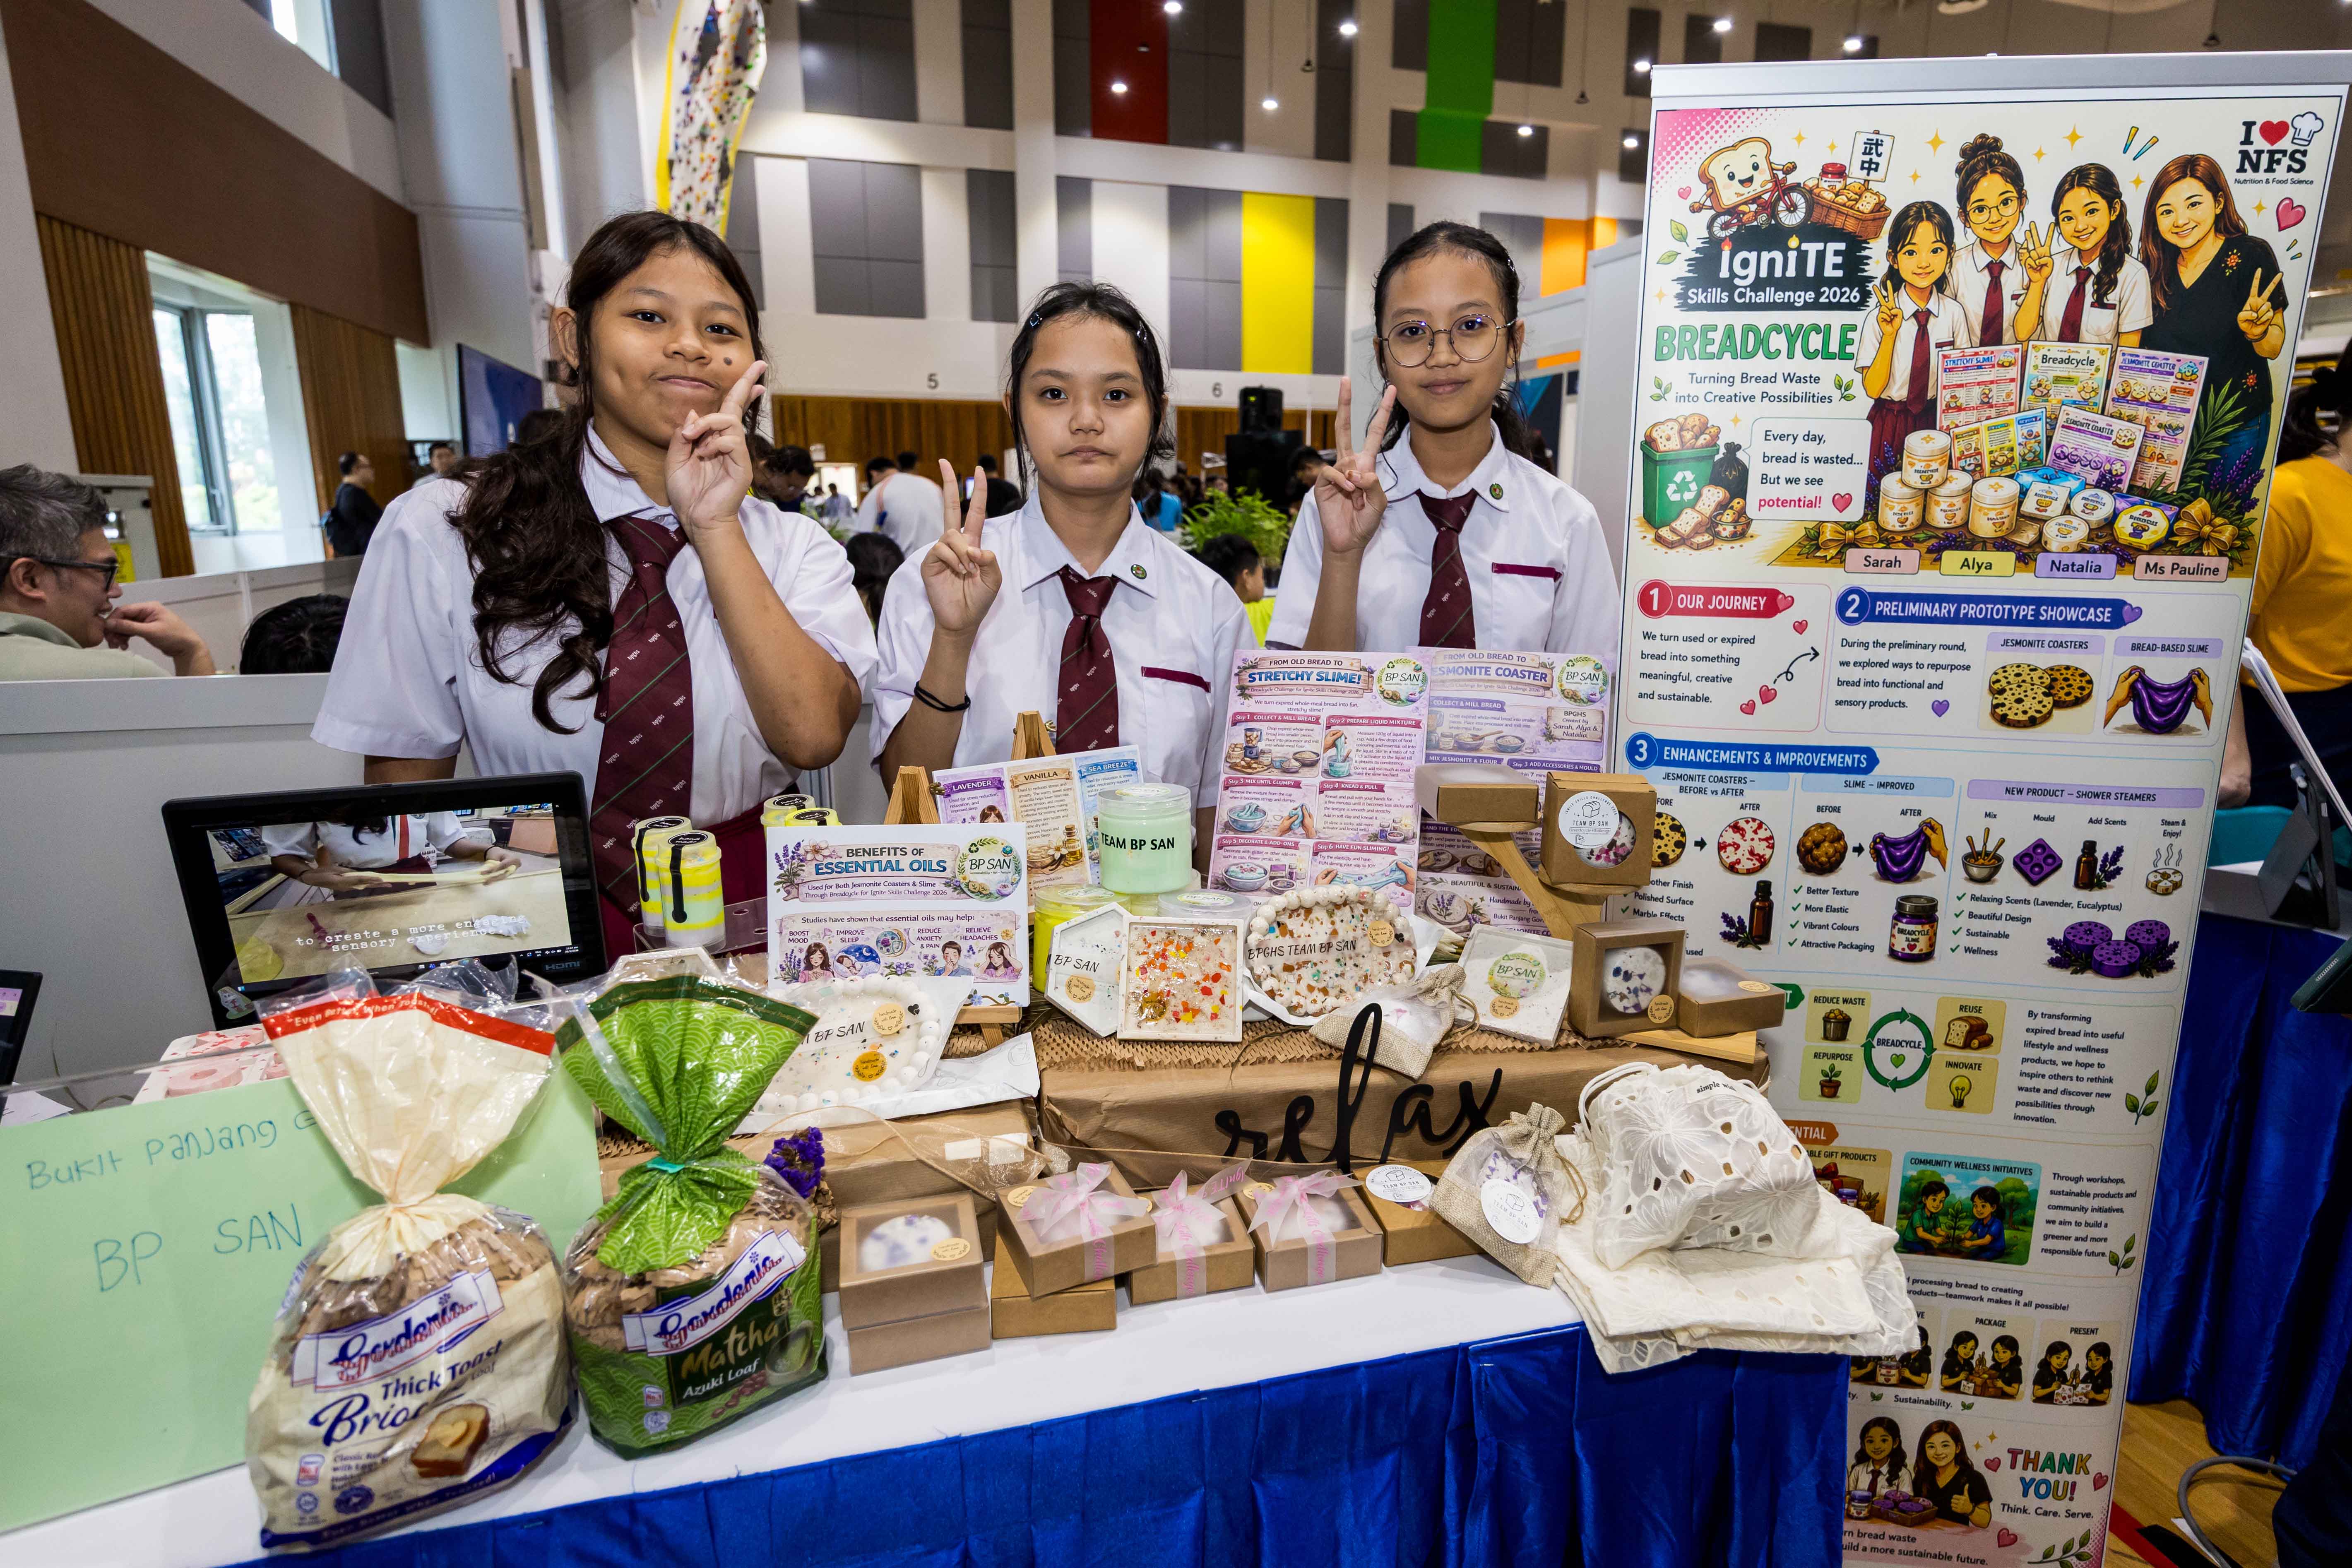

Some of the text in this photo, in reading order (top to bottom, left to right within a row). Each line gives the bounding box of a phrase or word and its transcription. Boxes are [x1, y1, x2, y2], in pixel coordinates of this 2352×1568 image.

[2239, 121, 2257, 146] I
[2236, 149, 2308, 174] NFS
[1687, 286, 1860, 307] Skills Challenge 2026
[1656, 324, 1857, 361] BREADCYCLE
[2041, 354, 2095, 368] Breadcycle
[927, 373, 939, 390] 5
[1688, 372, 1821, 387] Turning Bread Waste
[1212, 382, 1222, 398] 6
[1675, 391, 1833, 404] into Creative Possibilities
[1764, 430, 1826, 445] Every day,
[1763, 452, 1863, 465] bread is wasted...
[1760, 473, 1823, 486] But we see
[1758, 495, 1822, 512] potential!
[1863, 555, 1901, 568] Sarah
[1960, 557, 1992, 570] Alya
[2050, 559, 2102, 573] Natalia
[2145, 562, 2220, 576] Ms Pauline
[1650, 587, 1767, 611] 1 OUR JOURNEY
[1845, 594, 2112, 622] 2 PRELIMINARY PROTOTYPE SHOWCASE
[1642, 630, 1657, 641] We
[1659, 633, 1679, 642] turn
[1682, 633, 1705, 643] used
[1720, 635, 1756, 647] expired
[2001, 638, 2089, 649] JESMONITE COASTERS
[627, 649, 640, 660] bpghs
[2131, 642, 2209, 653] BREAD-BASED SLIME
[1248, 671, 1362, 685] STRETCHY SLIME!
[1385, 673, 1399, 681] BP
[1635, 739, 1867, 767] 3 ENHANCEMENTS & IMPROVEMENTS
[1103, 761, 1128, 771] BREEZE
[1023, 771, 1058, 781] VANILLA
[952, 779, 992, 791] LAVENDER
[1844, 780, 1915, 790] SLIME IMPROVED
[2005, 786, 2156, 802] NEW PRODUCT SHOWER STEAMERS
[1101, 832, 1174, 850] TEAM BP SAN
[846, 847, 924, 858] BENEFITS OF
[815, 859, 947, 875] ESSENTIAL OILS
[969, 858, 1011, 870] BP SAN
[1968, 911, 2031, 923] Beautiful Design
[295, 937, 314, 946] to
[325, 930, 380, 943] create
[409, 924, 445, 934] more
[1966, 928, 2010, 939] Sustainable
[332, 938, 396, 952] sensory
[1248, 940, 1356, 960] BPGHS TEAM BP SAN
[1964, 946, 1998, 956] Wellness
[1054, 955, 1099, 972] BP SAN
[1497, 964, 1537, 978] BP SAN
[1813, 996, 1866, 1006] REDUCE WASTE
[1959, 1004, 1983, 1014] REUSE
[295, 1013, 322, 1027] Even
[814, 1021, 865, 1042] BP SAN
[1876, 1038, 1922, 1049] BREADCYCLE
[1813, 1052, 1853, 1062] REPURPOSE
[1945, 1061, 1982, 1071] INNOVATE
[1214, 1003, 1502, 1173] relax
[1696, 1081, 1720, 1093] simple
[1910, 1157, 2033, 1176] COMMUNITY WELLNESS INITIATIVES
[95, 1203, 302, 1292] BP SAN
[1975, 1317, 2006, 1328] PACKAGE
[2070, 1327, 2099, 1335] PRESENT
[681, 1322, 778, 1379] Matcha
[382, 1341, 502, 1400] Thick Toast
[684, 1359, 760, 1398] Azuki Loaf
[1894, 1394, 1953, 1408] Sustainability.
[2008, 1449, 2092, 1475] THANK
[2020, 1477, 2076, 1501] YOU!
[2001, 1503, 2093, 1519] Think. Care. Serve.
